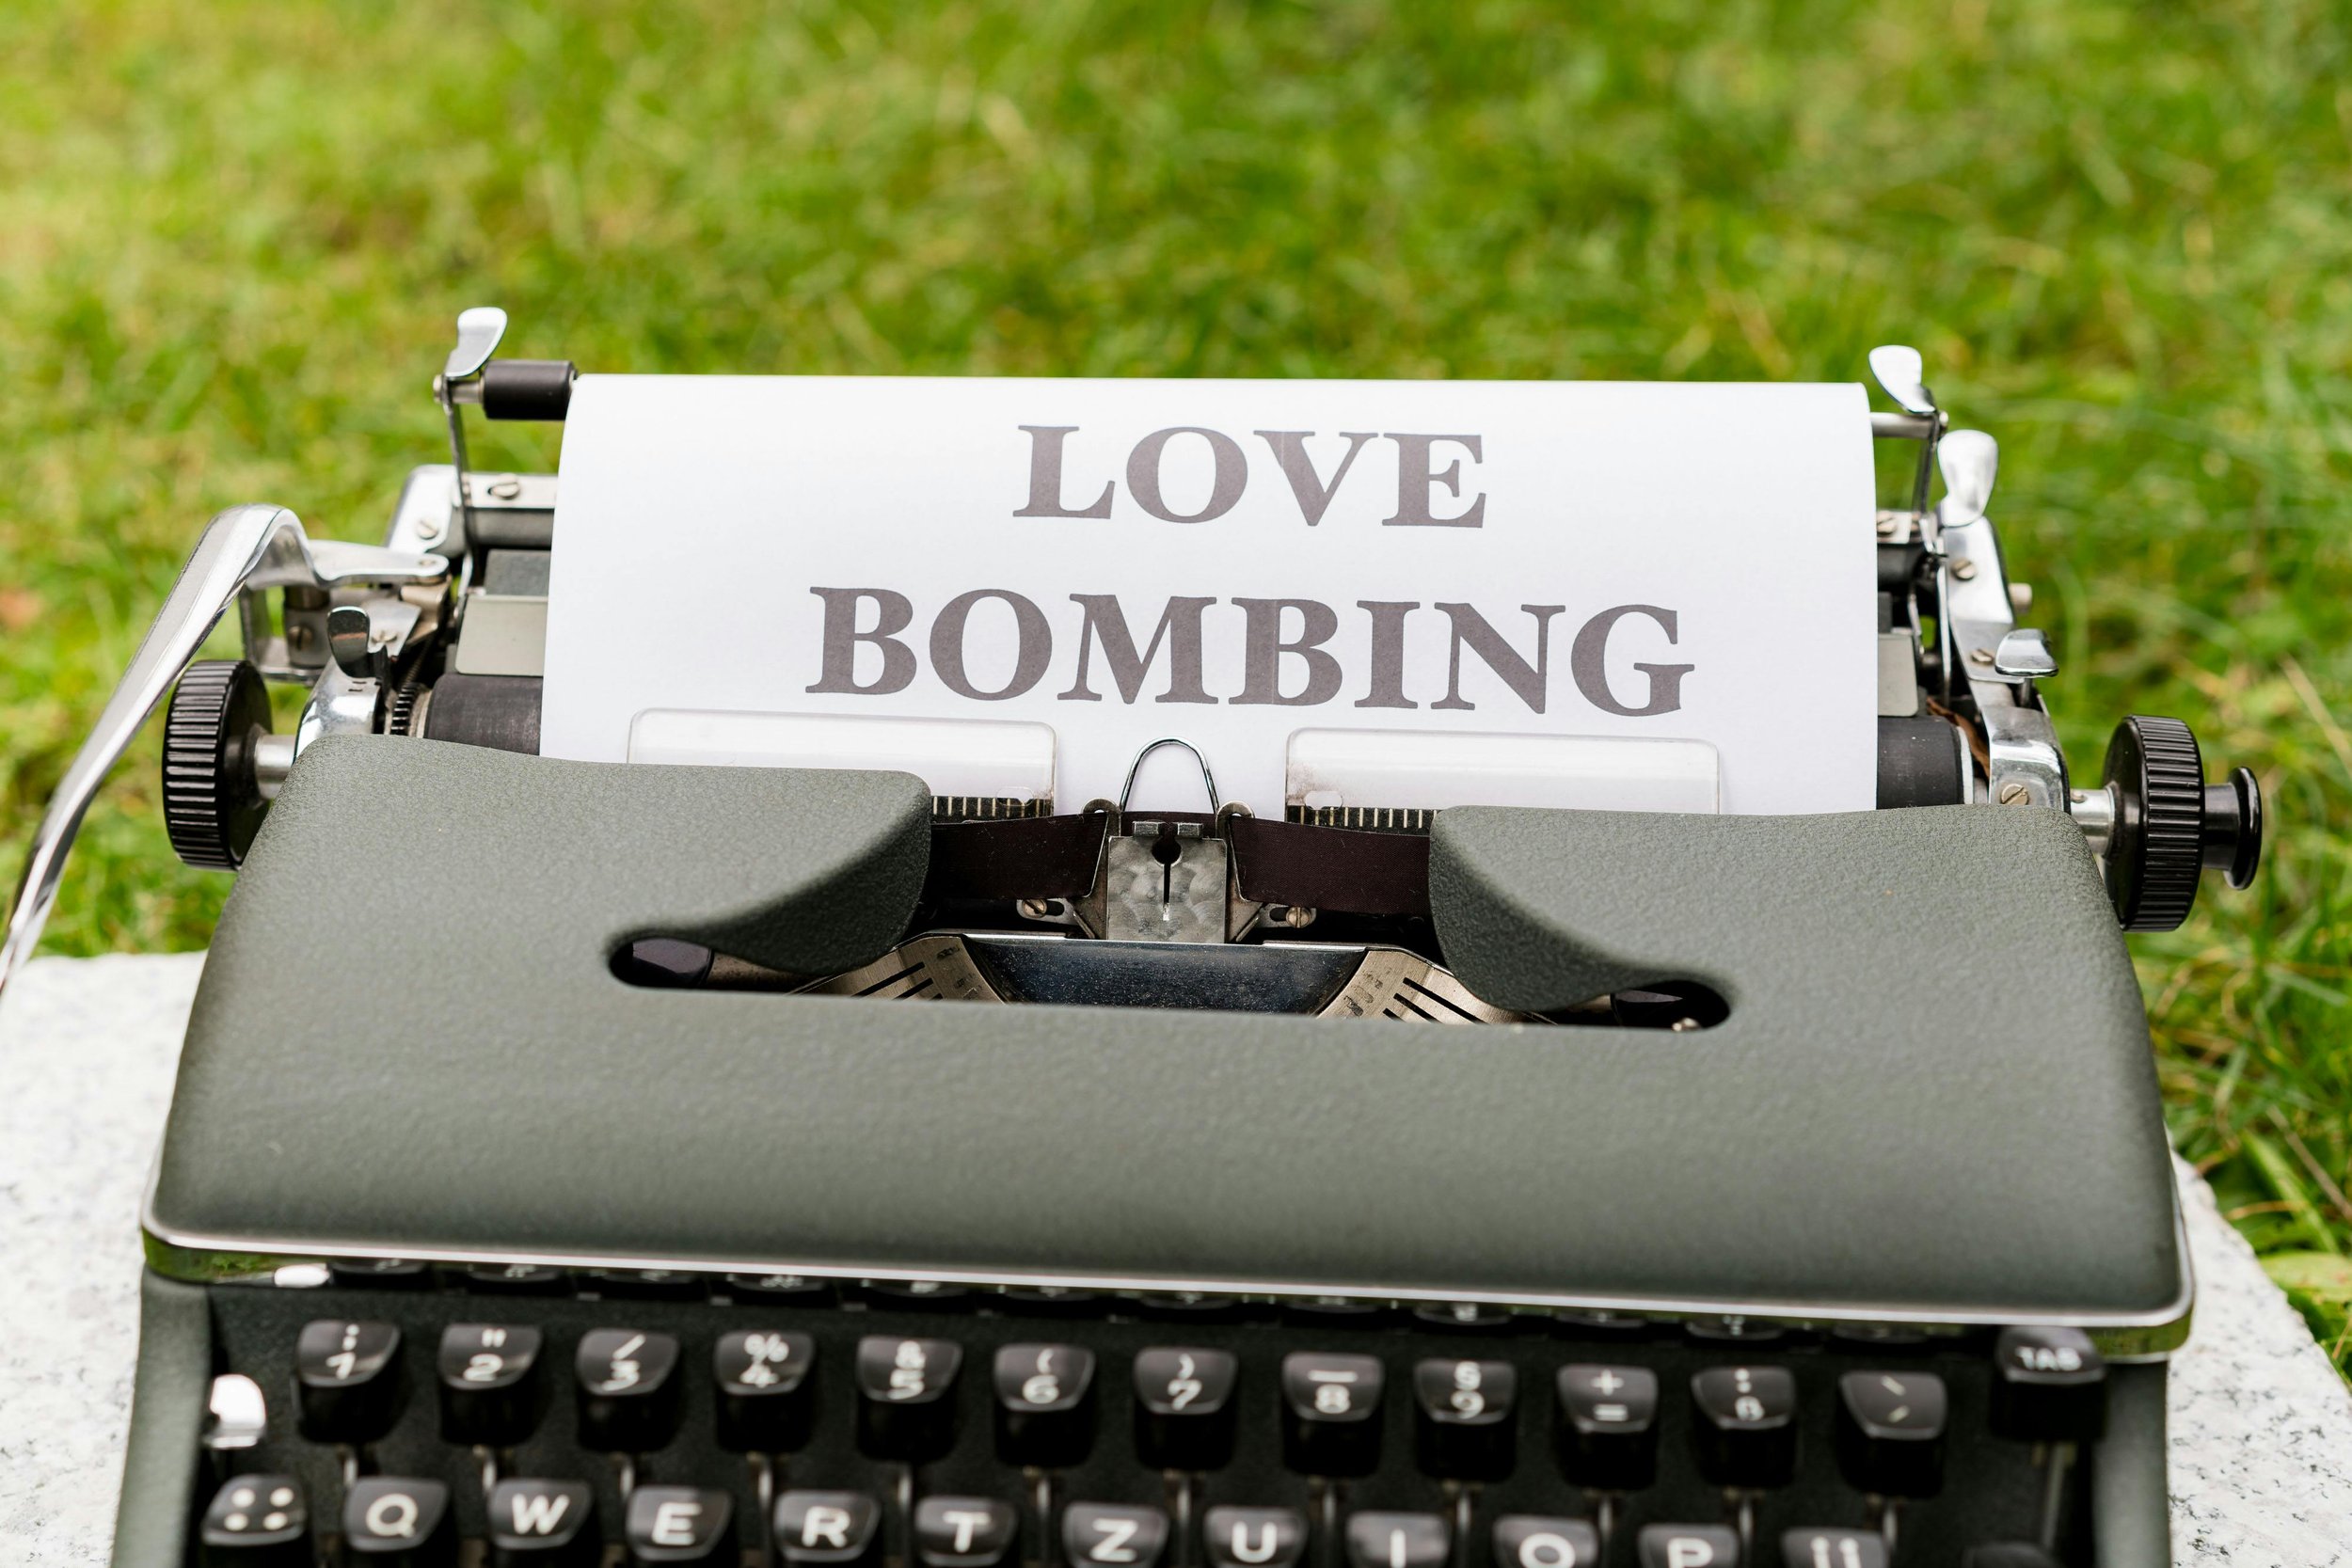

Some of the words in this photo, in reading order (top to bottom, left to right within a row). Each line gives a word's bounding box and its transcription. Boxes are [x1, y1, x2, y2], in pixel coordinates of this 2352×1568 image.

[1012, 424, 1486, 529] LOVE
[805, 587, 1694, 716] BOMBING
[744, 1334, 788, 1364] %
[2020, 1345, 2086, 1370] TAB
[327, 1352, 356, 1380] 1
[464, 1354, 503, 1382] 2
[603, 1359, 639, 1391] 3
[742, 1362, 774, 1387] 4
[890, 1368, 923, 1400] 5
[1023, 1373, 1058, 1404] 6
[1168, 1378, 1201, 1409] 7
[1591, 1370, 1624, 1395] +
[1316, 1384, 1349, 1414] 8
[1452, 1389, 1484, 1419] 9
[365, 1493, 417, 1536] Q
[511, 1493, 568, 1533] W
[651, 1500, 702, 1546] E
[803, 1505, 850, 1546] R
[942, 1510, 992, 1554] T
[1091, 1517, 1138, 1561] Z
[1232, 1522, 1278, 1561] U
[1389, 1528, 1407, 1568] I
[1520, 1532, 1576, 1568] O
[1667, 1537, 1713, 1568] P
